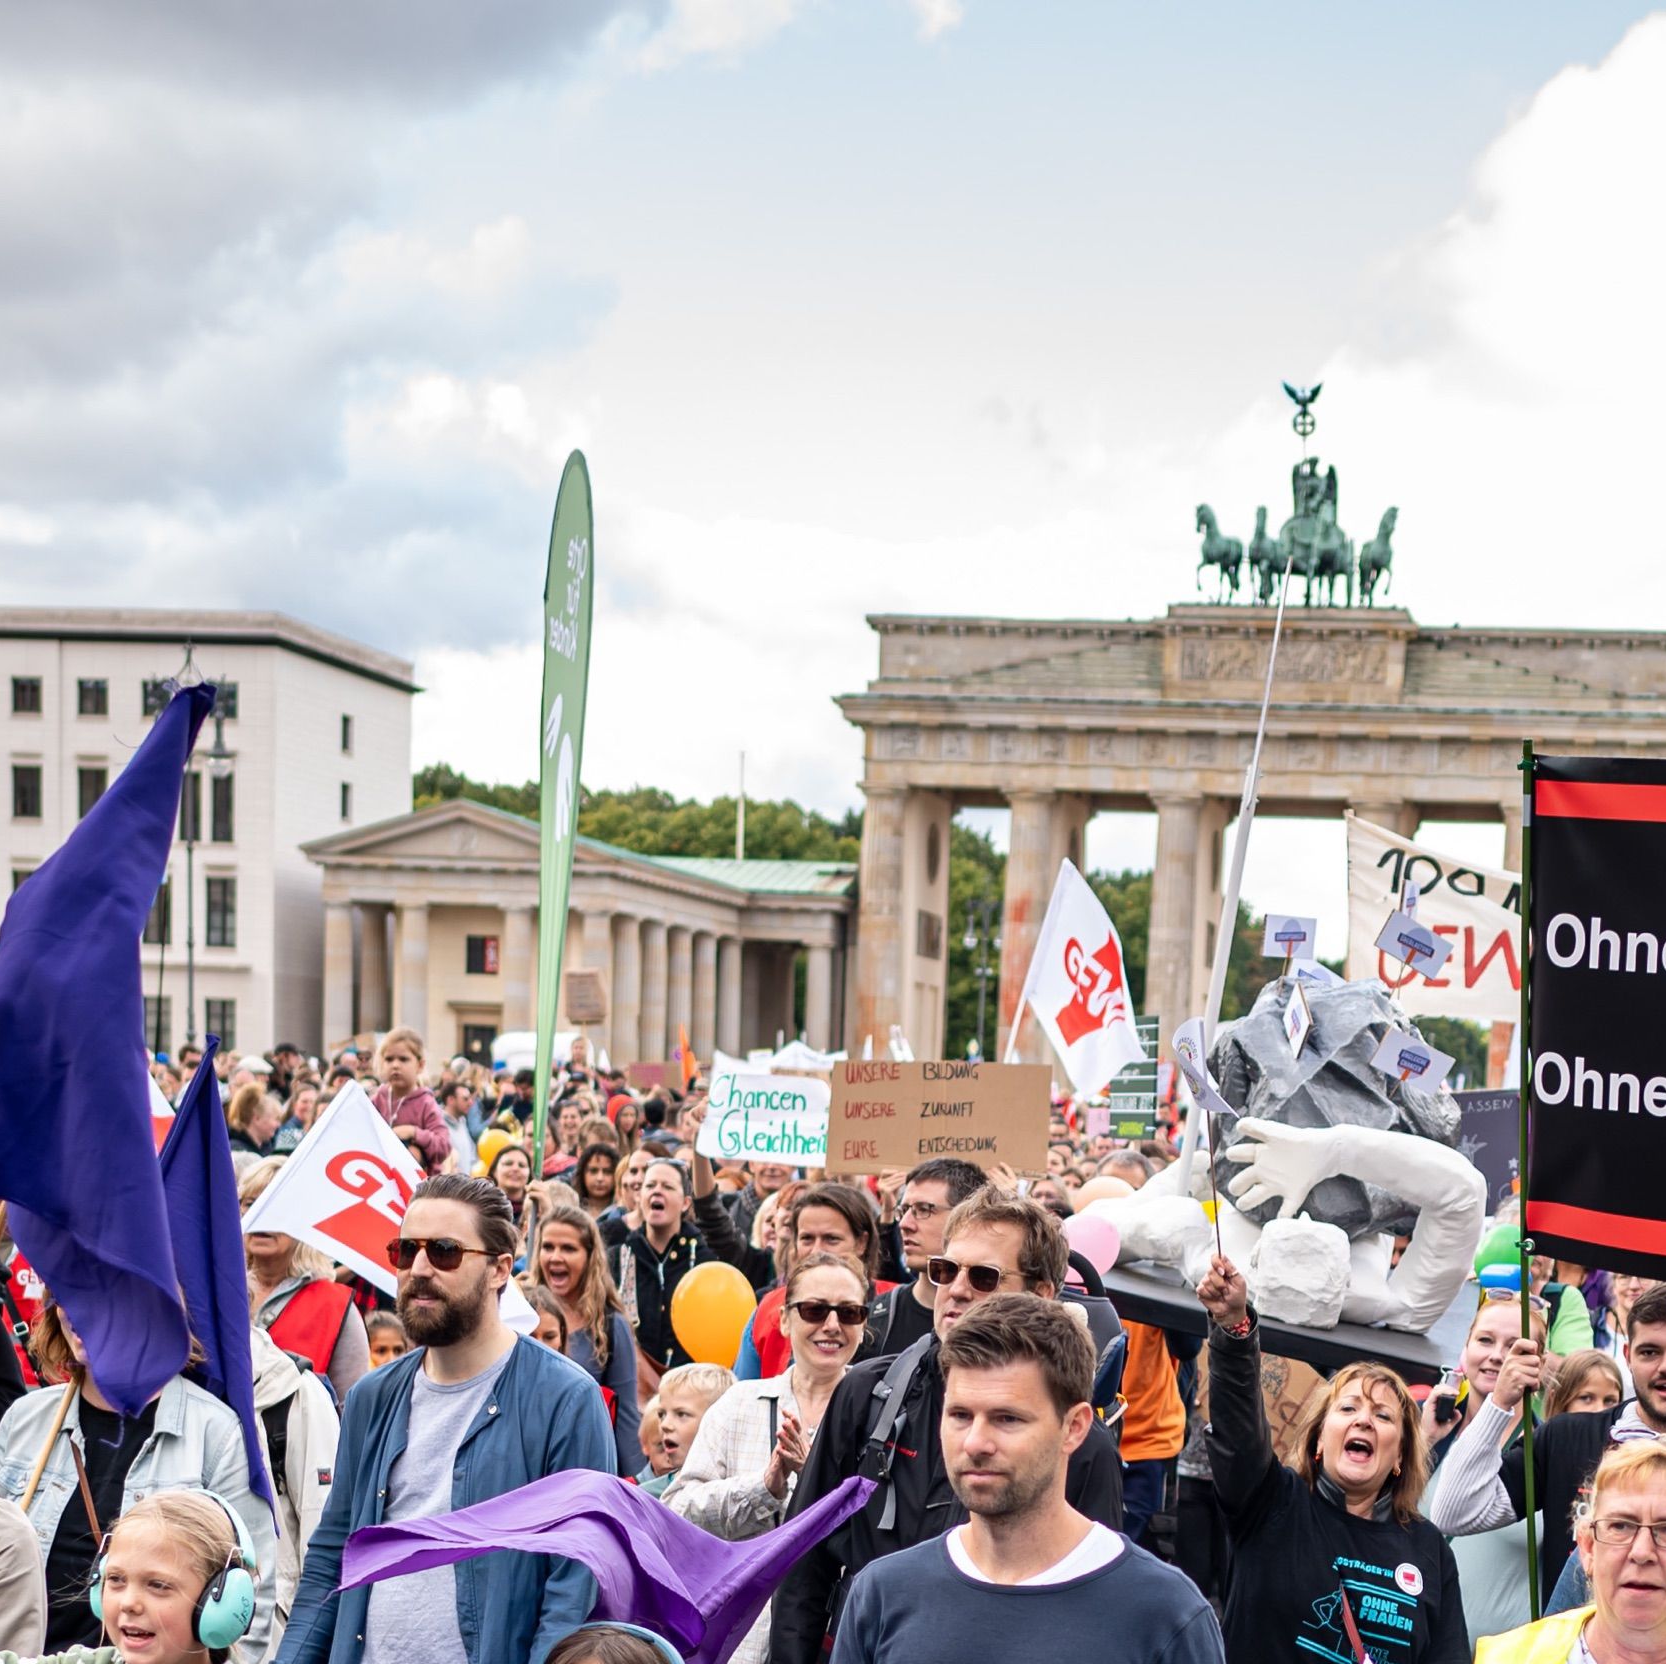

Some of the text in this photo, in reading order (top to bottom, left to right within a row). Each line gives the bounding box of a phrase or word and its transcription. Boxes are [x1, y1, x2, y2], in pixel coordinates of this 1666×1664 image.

[845, 1063, 901, 1084] UNSERE
[922, 1062, 979, 1081] BILDUNG
[708, 1074, 807, 1111] Chancen
[845, 1101, 975, 1119] UNSERE ZUKUNFT
[843, 1136, 997, 1161] EURE ENTSCHEIDUNG
[1361, 1595, 1399, 1614] OHNE
[1359, 1607, 1414, 1632] FRAUEN
